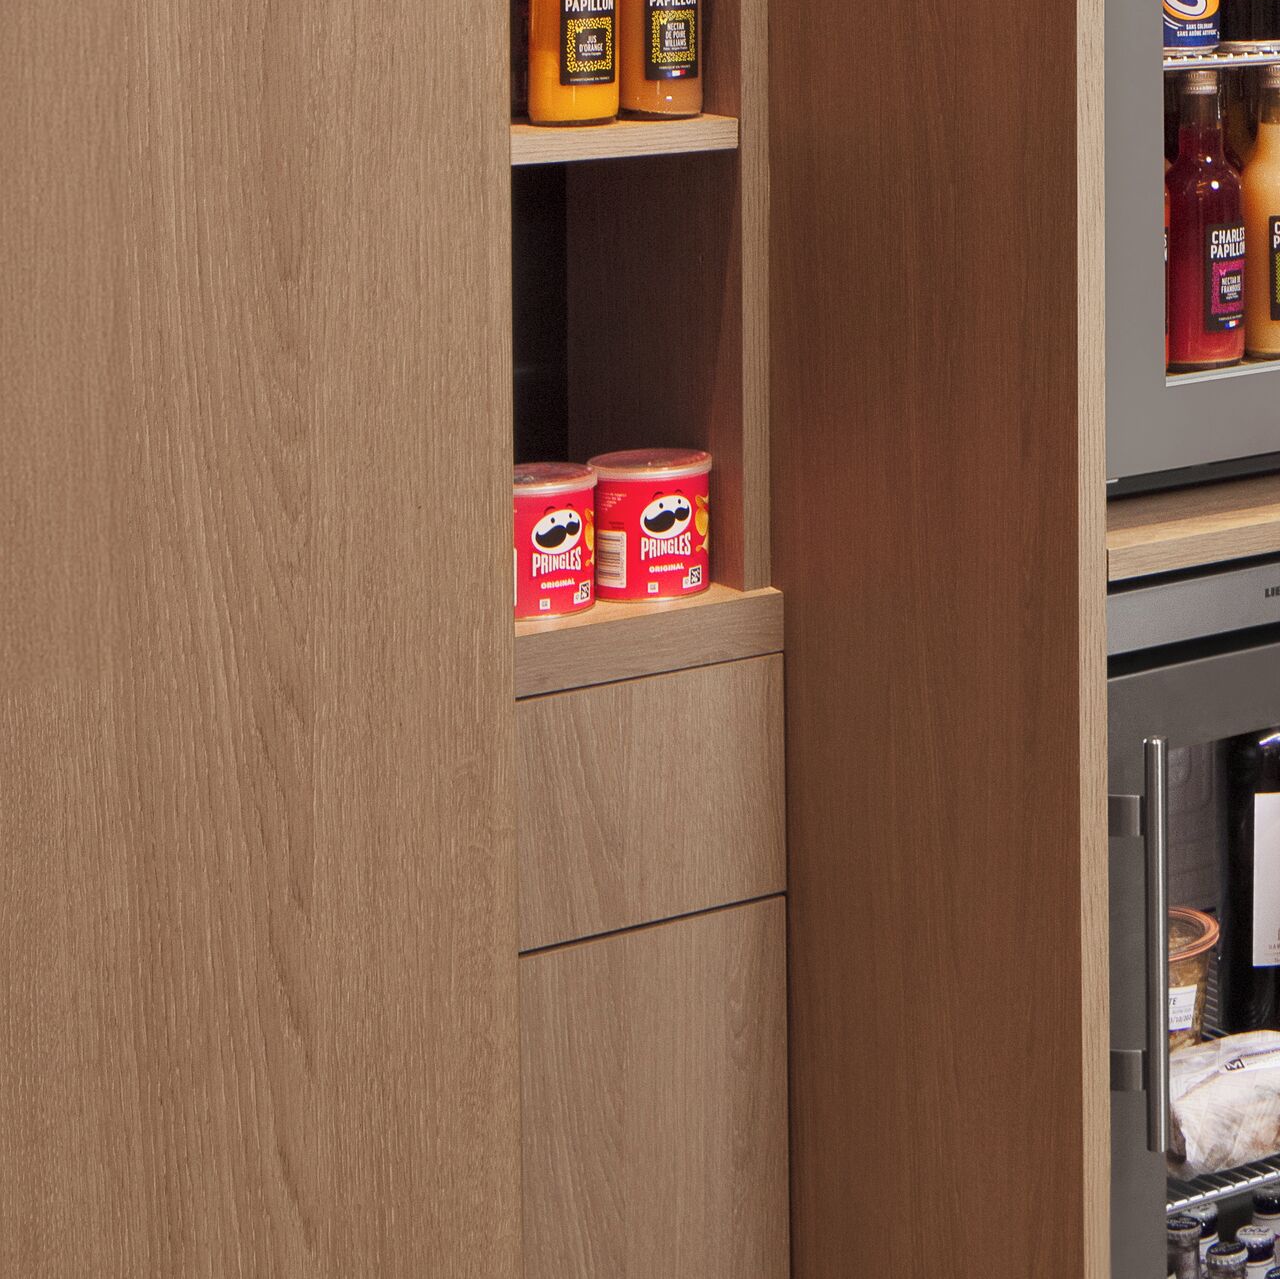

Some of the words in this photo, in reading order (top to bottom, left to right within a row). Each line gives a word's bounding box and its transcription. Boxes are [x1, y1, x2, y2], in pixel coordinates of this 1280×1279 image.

[640, 532, 692, 561] PRINGLES
[532, 546, 582, 577] PRINGLES
[649, 563, 685, 573] ORIGINAL
[540, 578, 575, 590] ORIGINAL
